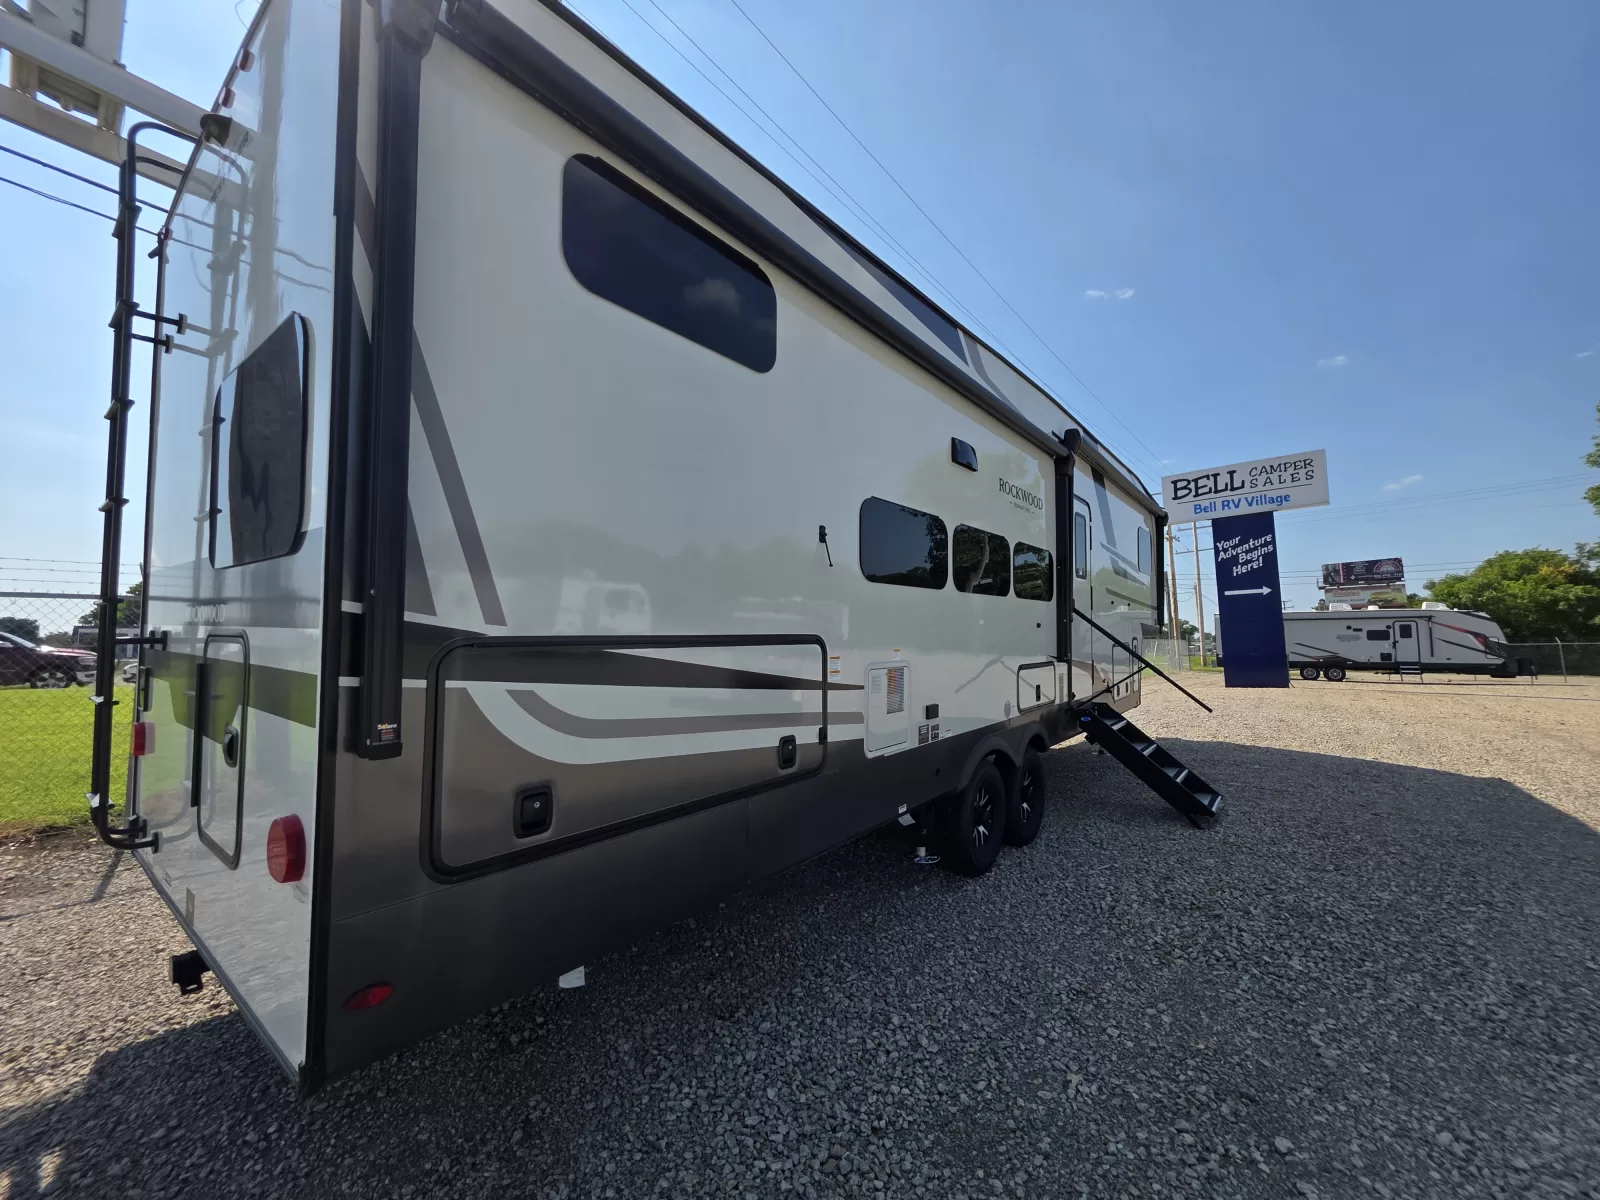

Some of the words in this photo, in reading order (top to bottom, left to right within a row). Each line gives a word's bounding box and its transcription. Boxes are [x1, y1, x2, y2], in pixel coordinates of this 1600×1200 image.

[1170, 469, 1245, 501] BELL
[1249, 458, 1315, 478] CAMPER
[1249, 469, 1315, 489] SALES
[998, 477, 1044, 510] ROCKWOOD
[1193, 501, 1217, 515] Bell
[1221, 498, 1242, 511] RV
[1244, 493, 1291, 507] Village
[1216, 536, 1241, 551] Your
[1218, 534, 1272, 562] Adventure
[1238, 544, 1274, 563] Begins
[1232, 556, 1263, 577] Here!
